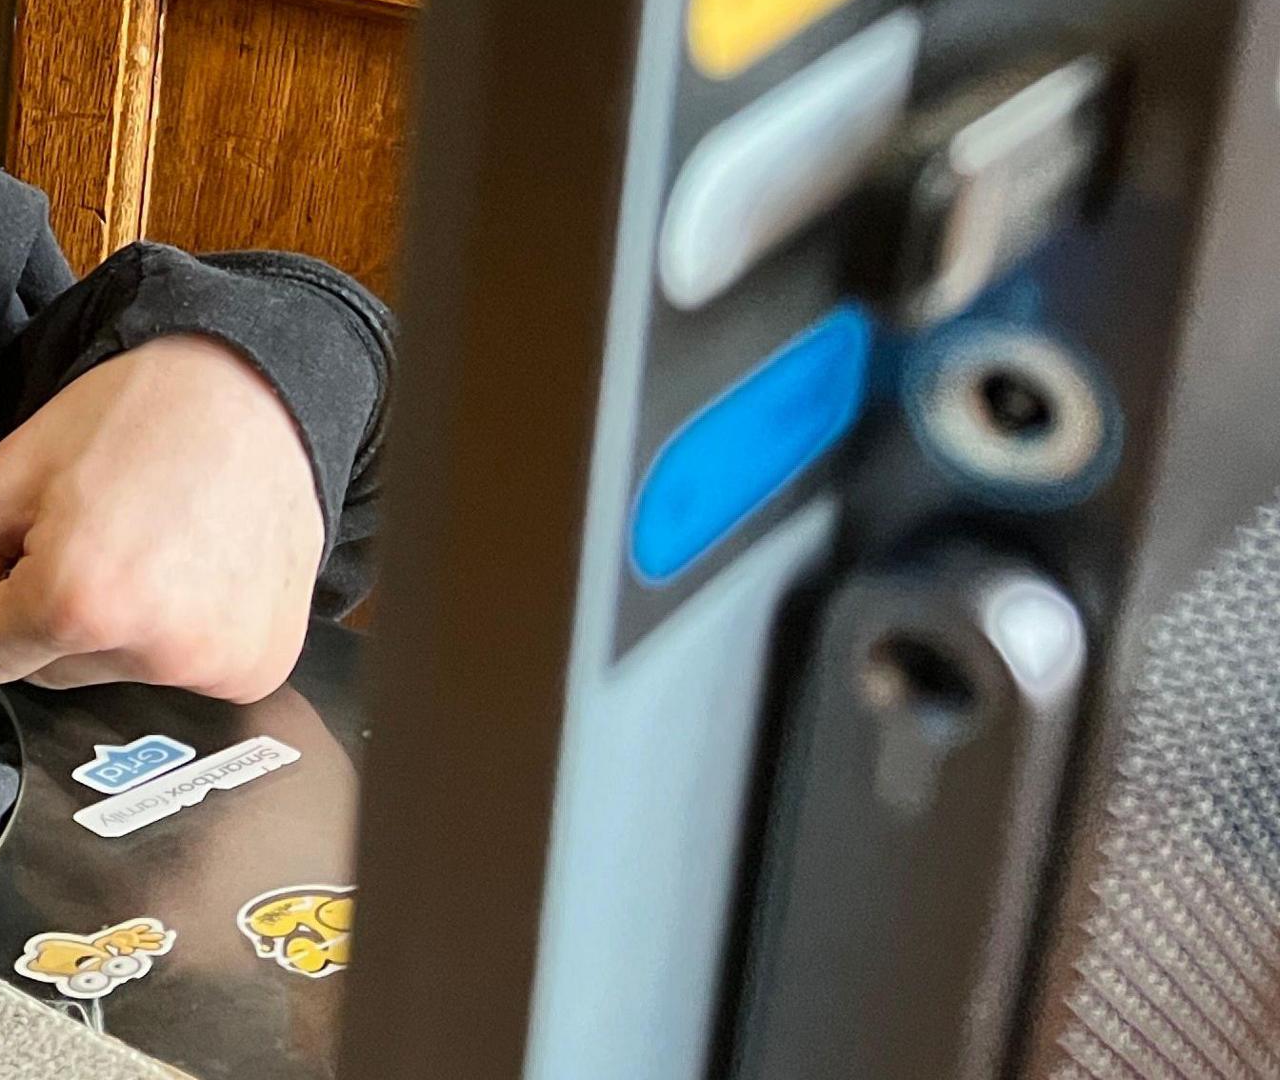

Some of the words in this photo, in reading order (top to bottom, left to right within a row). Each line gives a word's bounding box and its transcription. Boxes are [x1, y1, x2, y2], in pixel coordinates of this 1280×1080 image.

[95, 746, 169, 784] Grid
[164, 746, 281, 798] Smartbox
[99, 794, 171, 828] family
